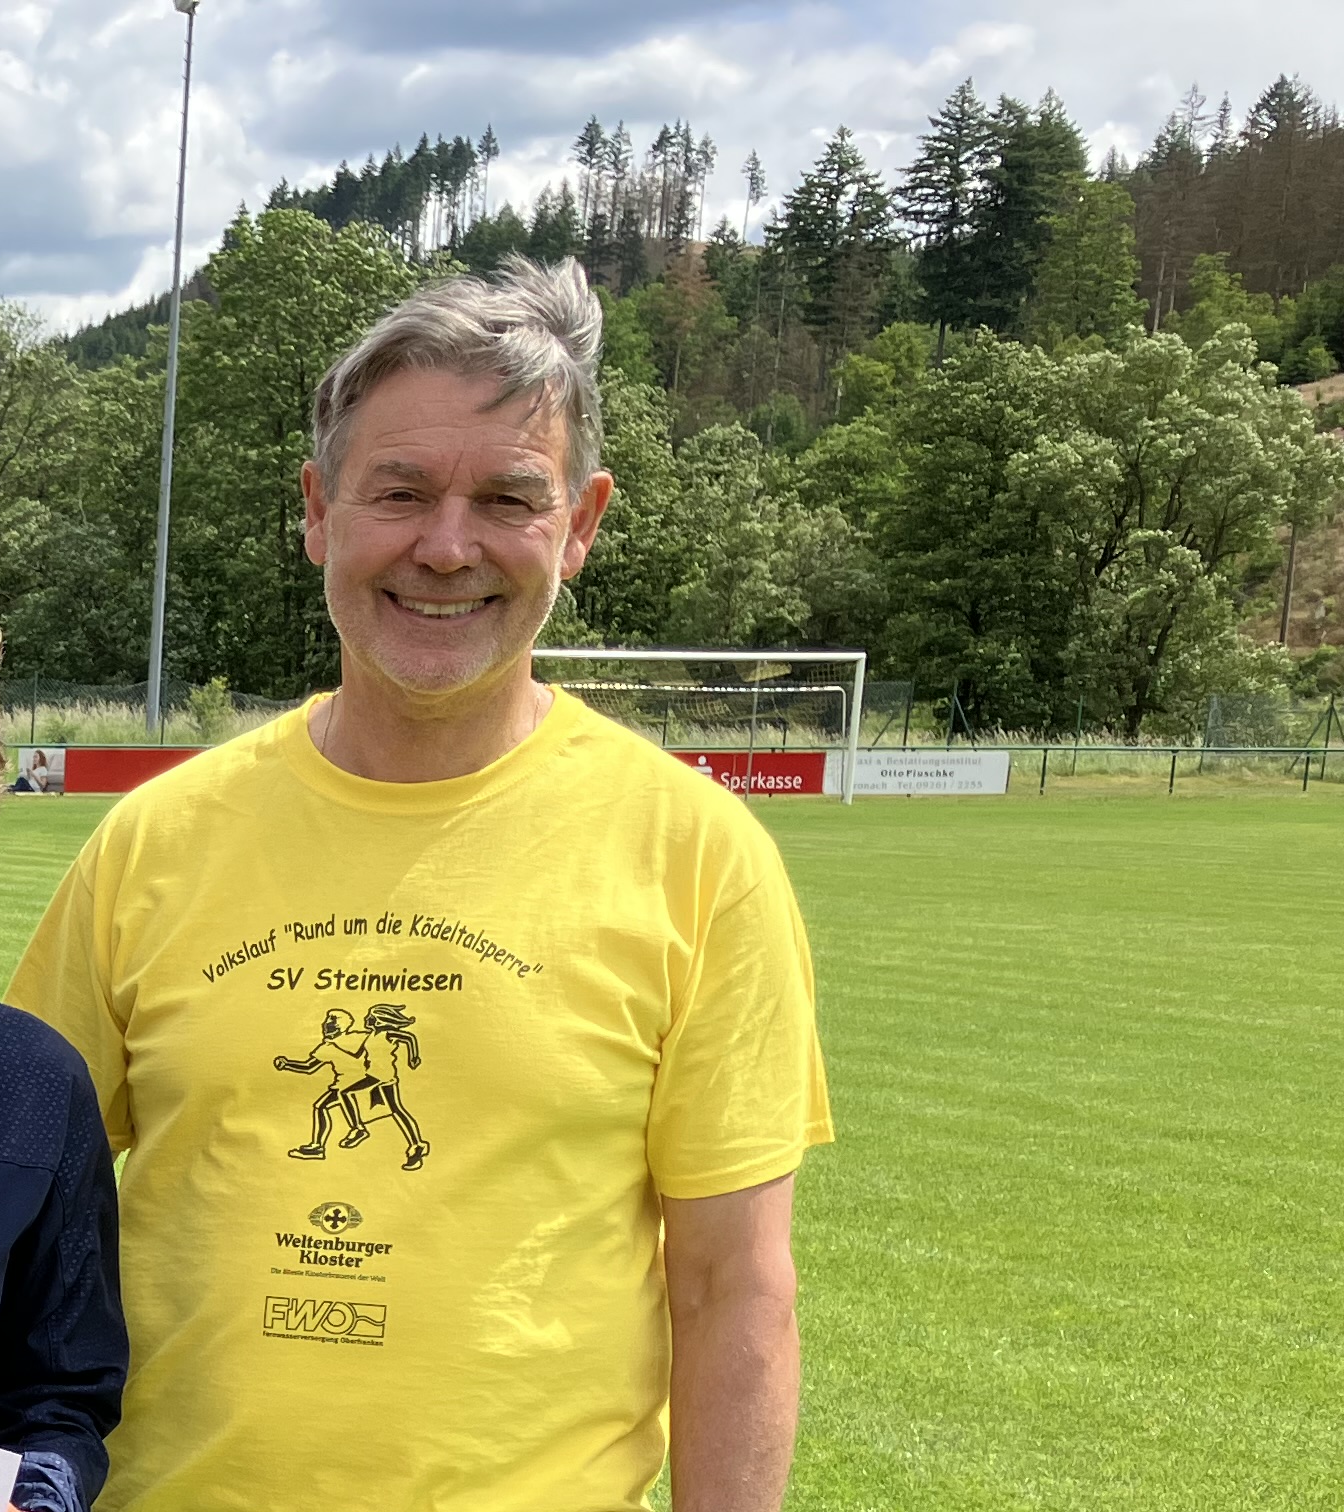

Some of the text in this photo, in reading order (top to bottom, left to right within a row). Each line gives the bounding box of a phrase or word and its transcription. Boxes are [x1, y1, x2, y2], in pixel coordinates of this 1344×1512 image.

[720, 771, 803, 792] Sparkasse
[202, 911, 544, 983] Volkslauf "Rund um die Ködeltalsperre"
[266, 967, 463, 992] SV Steinwiesen
[275, 1232, 393, 1257] Weltenburger
[299, 1250, 363, 1268] Kloster
[263, 1295, 355, 1335] FWO
